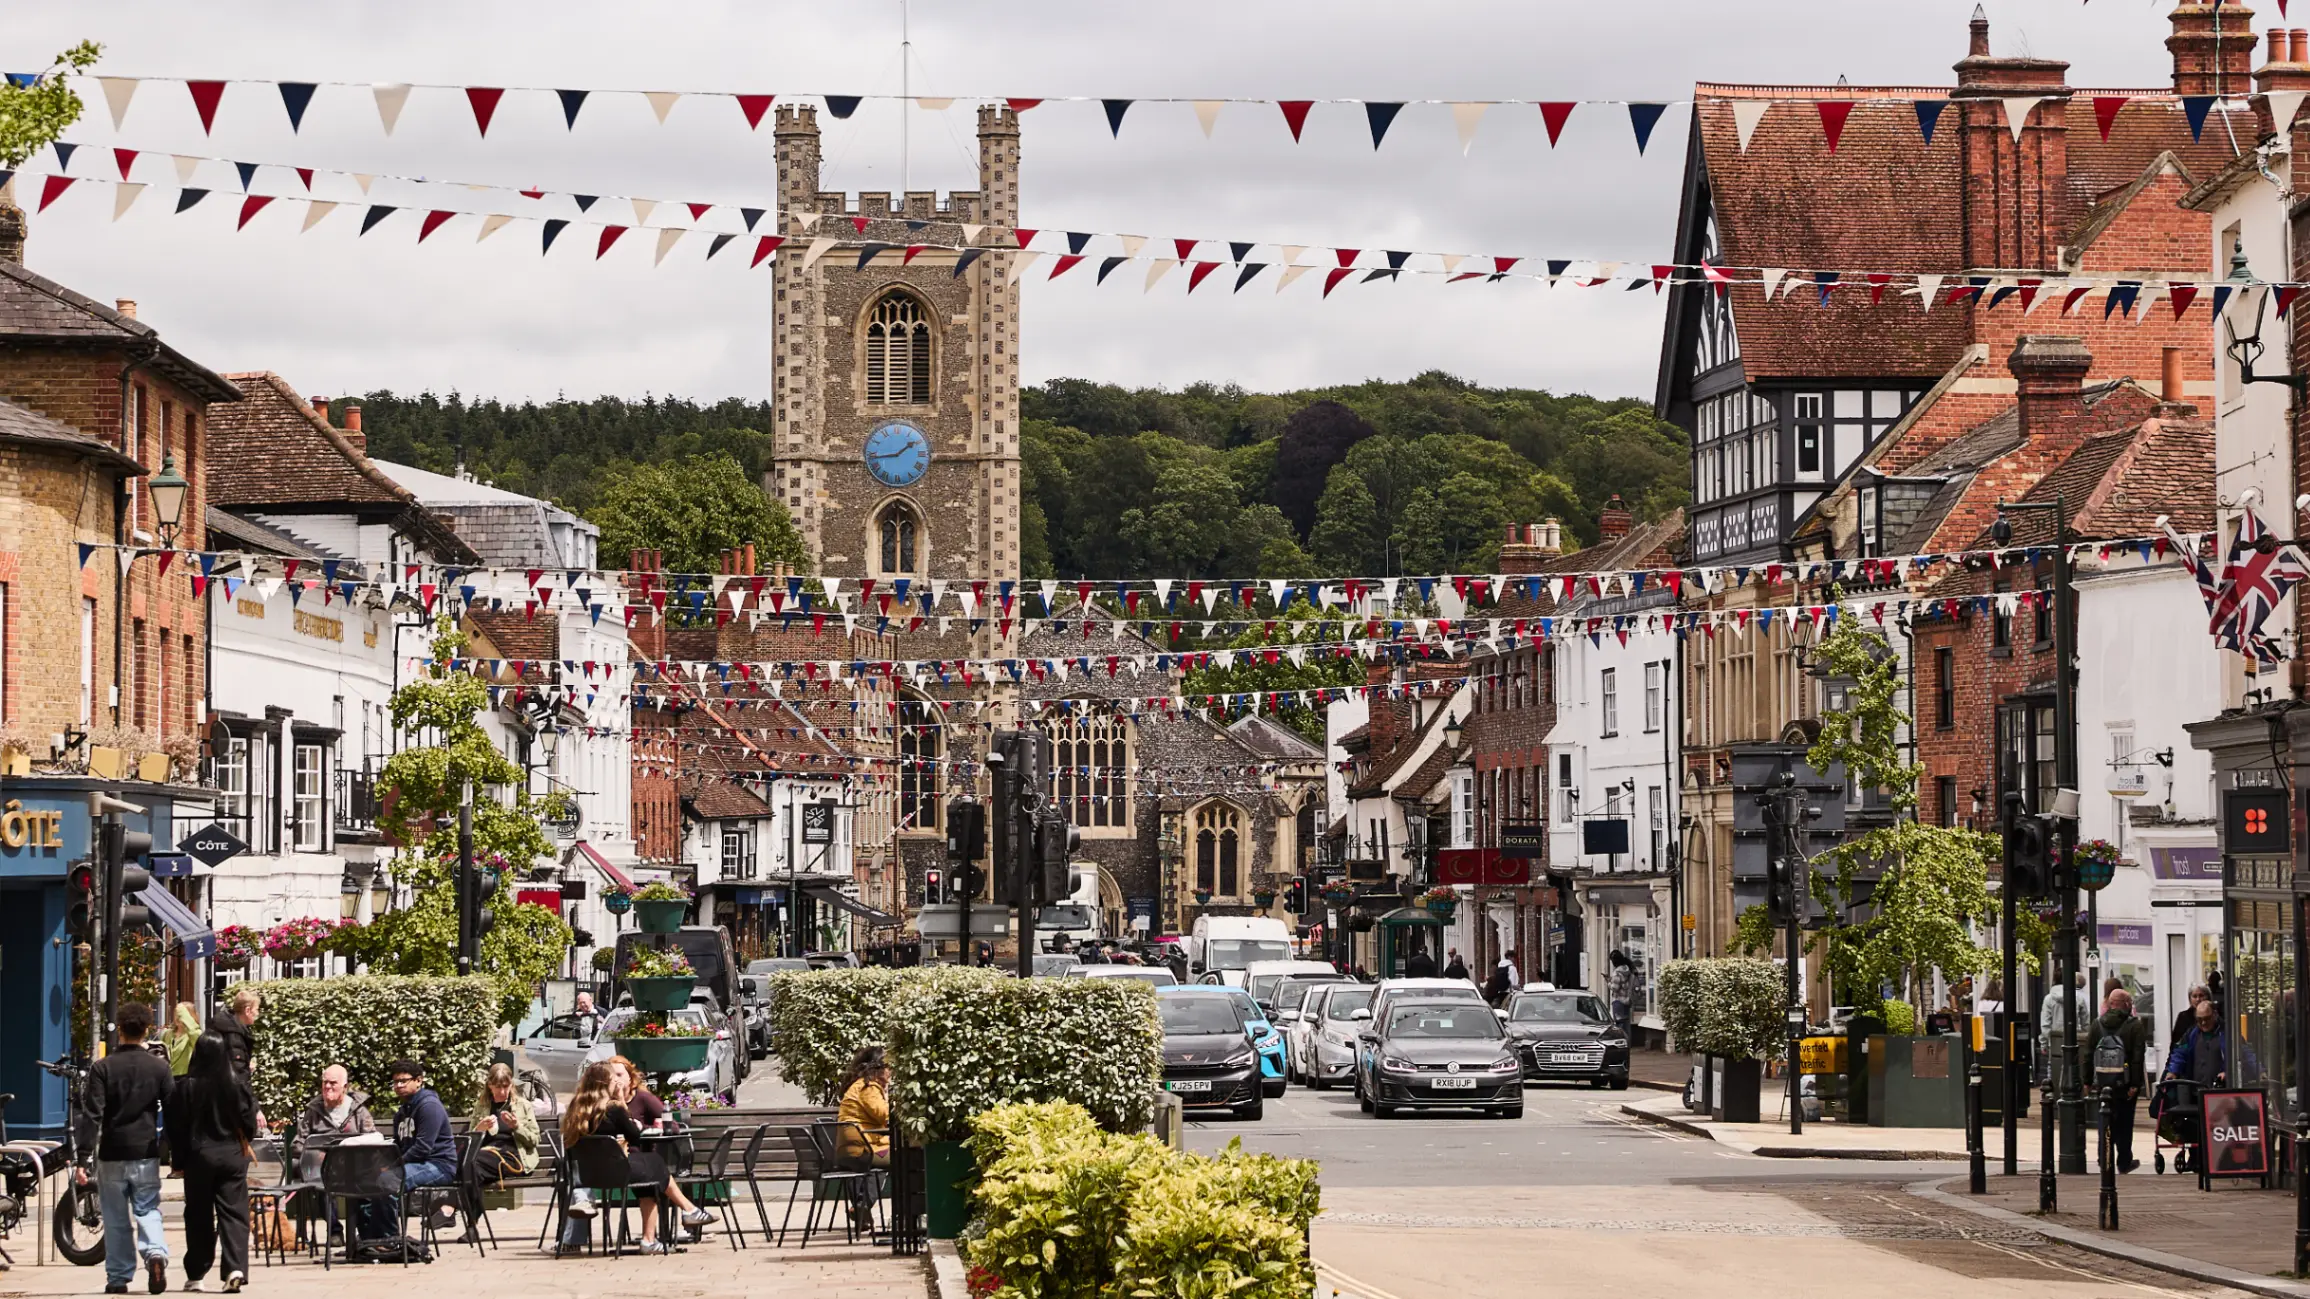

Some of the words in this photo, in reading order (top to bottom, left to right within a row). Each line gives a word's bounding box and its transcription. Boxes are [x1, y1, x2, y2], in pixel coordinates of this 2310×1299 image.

[0, 799, 63, 848] ÔTE
[195, 839, 229, 851] CÔTE
[1505, 837, 1538, 845] DORATA
[2172, 855, 2191, 875] frost
[1171, 1081, 1193, 1090] KJ25
[1194, 1081, 1210, 1090] EPV
[1436, 1079, 1454, 1087] RX18
[2213, 1126, 2259, 1141] SALE
